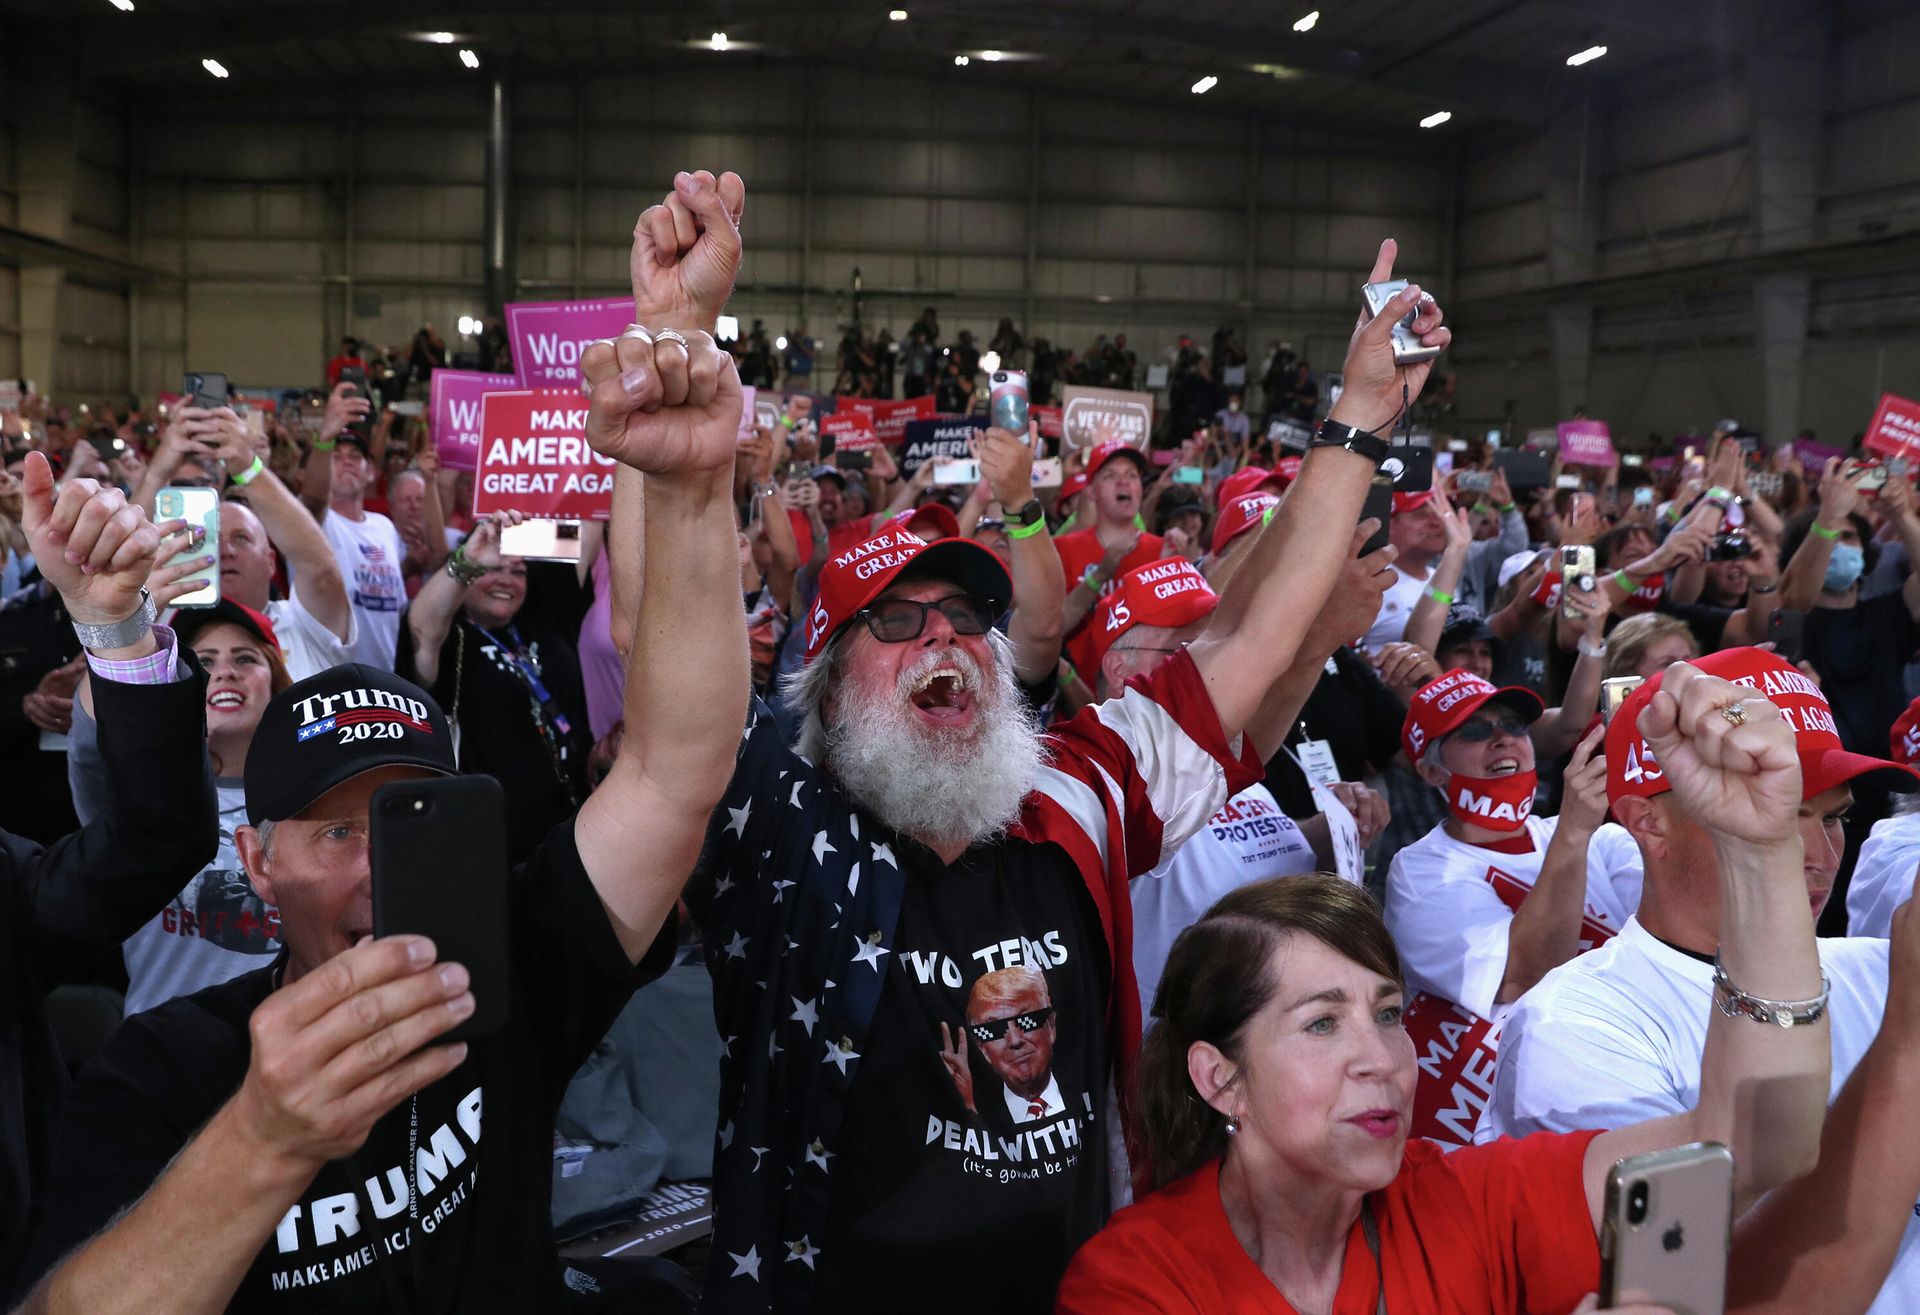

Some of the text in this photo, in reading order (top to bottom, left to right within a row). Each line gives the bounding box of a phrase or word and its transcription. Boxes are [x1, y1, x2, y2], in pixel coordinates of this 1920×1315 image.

[527, 333, 590, 366] Wo
[545, 367, 577, 380] FOR
[459, 432, 479, 447] FO
[933, 426, 972, 440] MAKE
[906, 441, 969, 458] AMERI
[483, 473, 614, 494] GREAT AGA
[834, 535, 894, 569] MAKE
[855, 548, 916, 580] GREAT
[1136, 562, 1180, 585] MAKE
[1154, 577, 1200, 599] GREAT
[1106, 598, 1131, 632] 45
[1418, 676, 1458, 704] MAKE
[1437, 683, 1478, 712] GREAT
[292, 688, 428, 726] Trump
[338, 722, 404, 744] 2020
[410, 1128, 418, 1172] PALMER
[926, 1114, 999, 1160] DEAL
[998, 1118, 1080, 1162] WITH
[275, 1085, 483, 1254] TRUMP
[1044, 1160, 1062, 1175] be
[410, 1174, 418, 1218] ARNOLD
[638, 1197, 706, 1222] TRUMP
[272, 1262, 330, 1290] MAKE
[421, 1182, 466, 1233] GREAT
[645, 1223, 682, 1240] 2020
